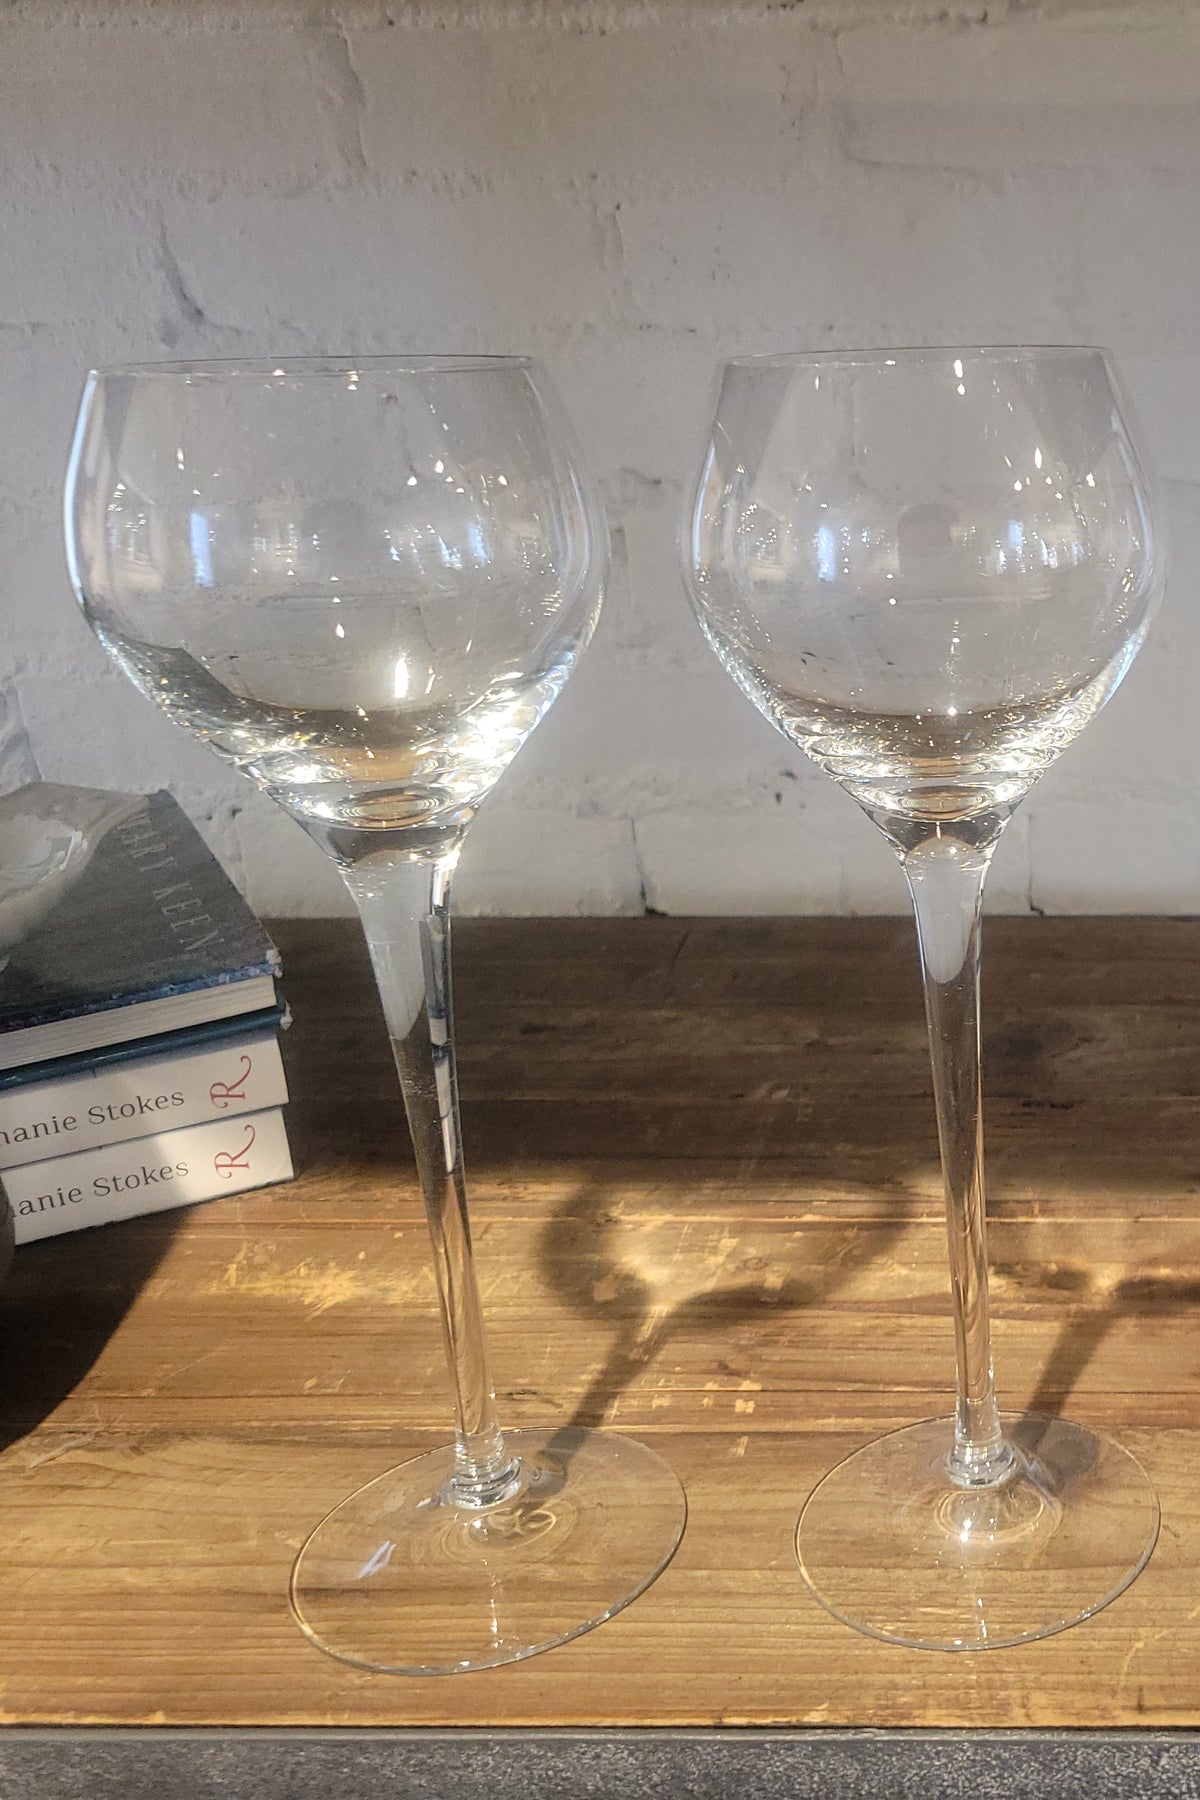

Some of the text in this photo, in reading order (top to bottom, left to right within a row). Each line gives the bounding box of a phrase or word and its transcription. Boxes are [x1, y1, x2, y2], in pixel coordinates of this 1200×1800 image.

[87, 1091, 185, 1125] Stokes
[209, 1055, 252, 1109] R
[213, 1124, 256, 1180] R
[12, 1161, 189, 1218] anie Stokes
